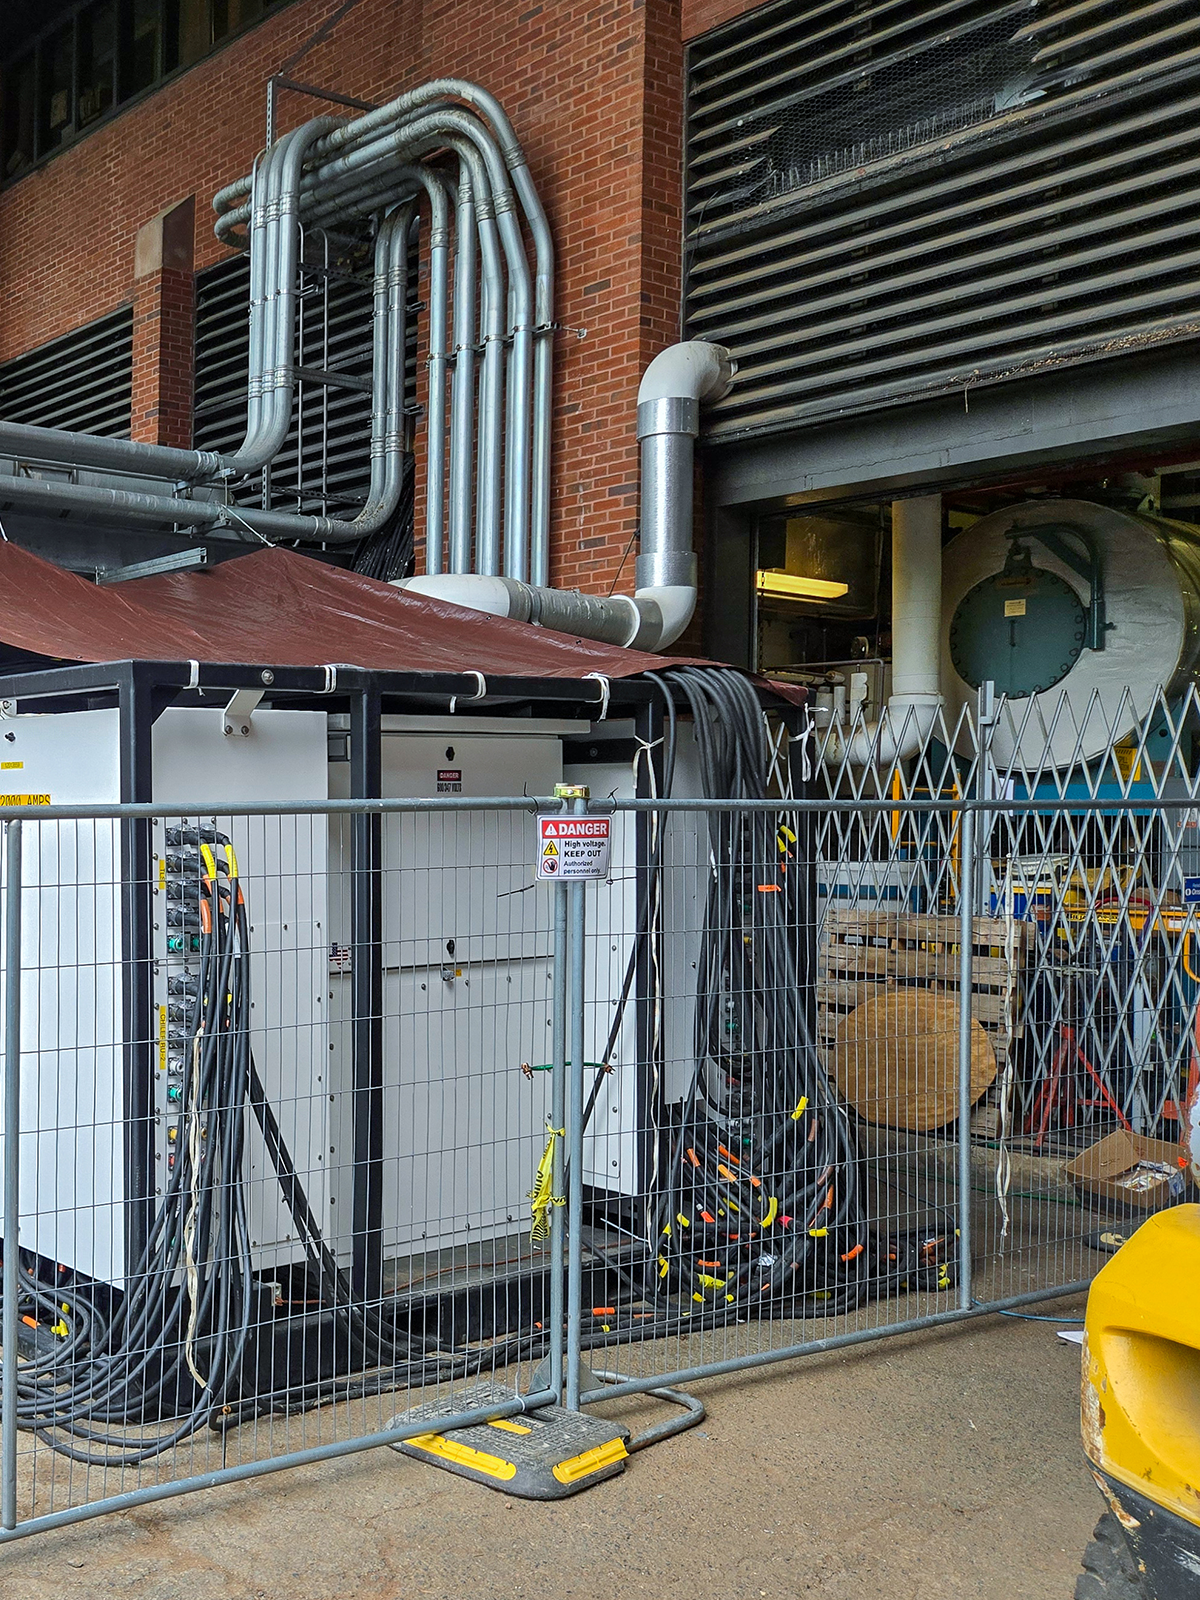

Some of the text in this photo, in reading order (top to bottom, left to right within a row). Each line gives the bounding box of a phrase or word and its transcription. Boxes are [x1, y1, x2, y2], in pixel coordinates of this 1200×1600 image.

[27, 794, 51, 806] AMPS
[559, 823, 607, 836] DANGER
[564, 840, 581, 849] High
[563, 867, 590, 875] personnel
